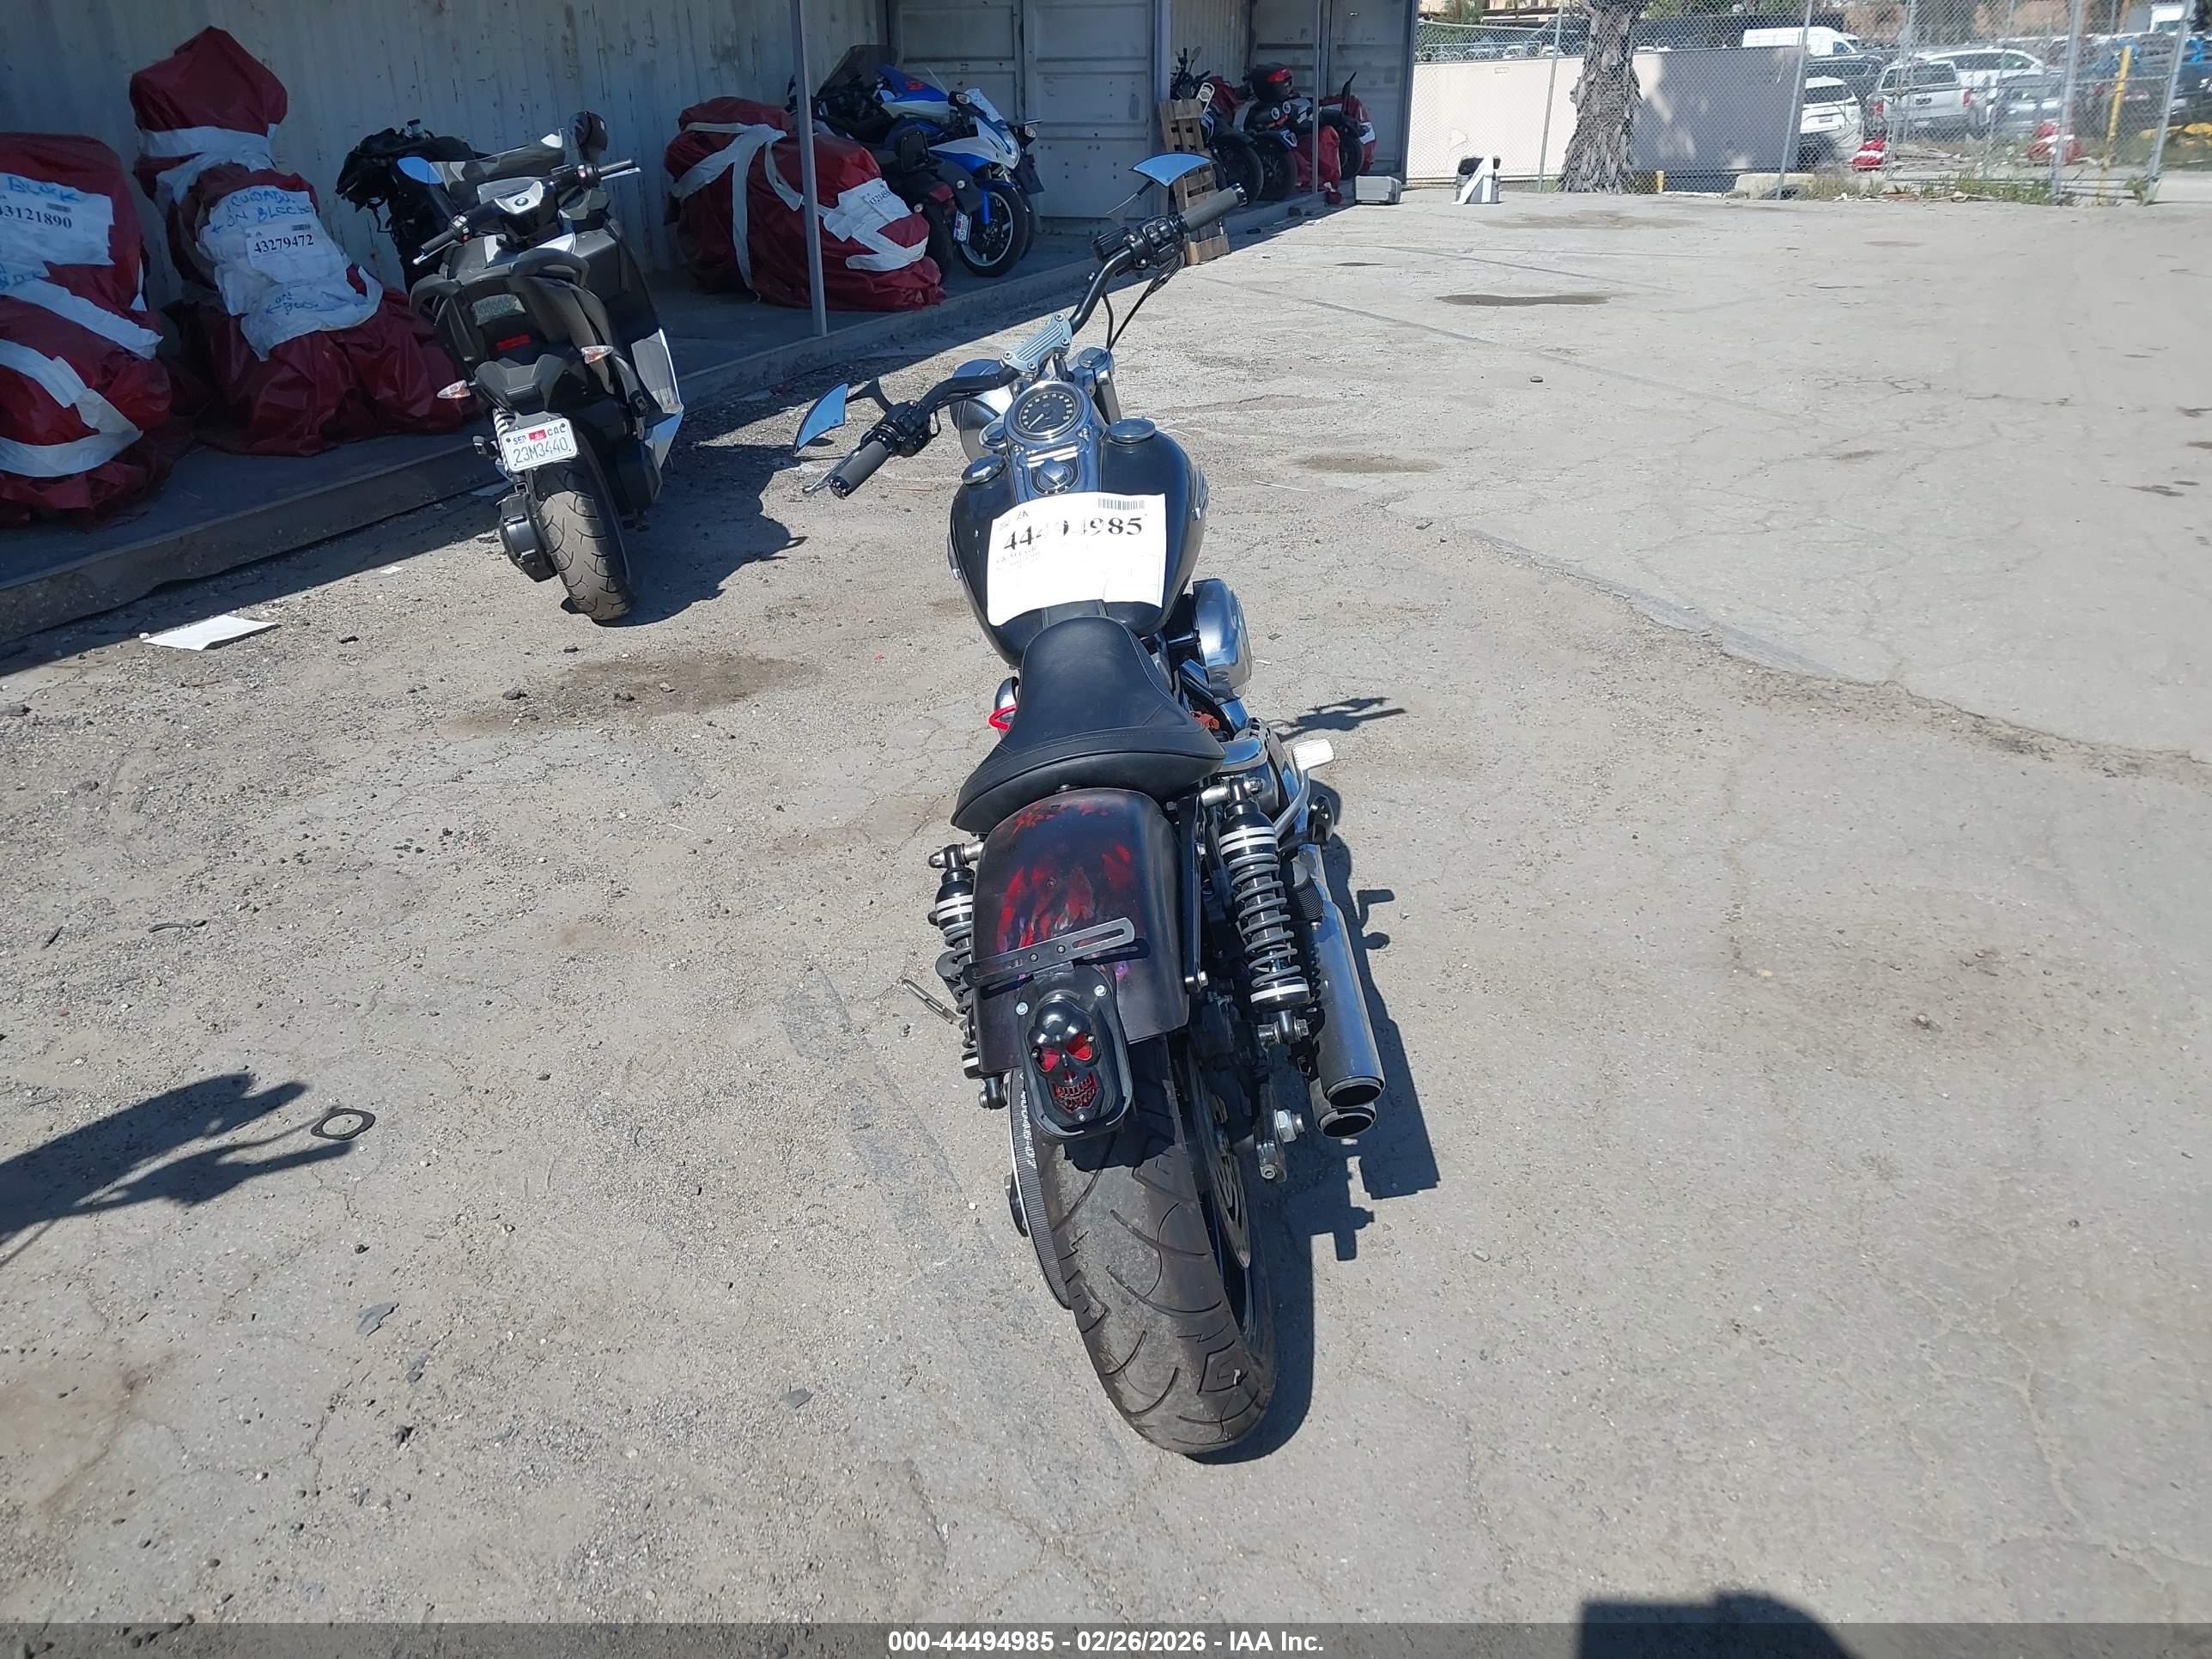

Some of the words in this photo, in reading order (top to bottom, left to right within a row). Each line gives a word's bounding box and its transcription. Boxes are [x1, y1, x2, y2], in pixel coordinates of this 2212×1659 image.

[0, 205, 72, 229] 3121890
[253, 234, 314, 253] 43279472
[513, 436, 568, 464] 23M3440
[1003, 517, 1143, 550] 44985
